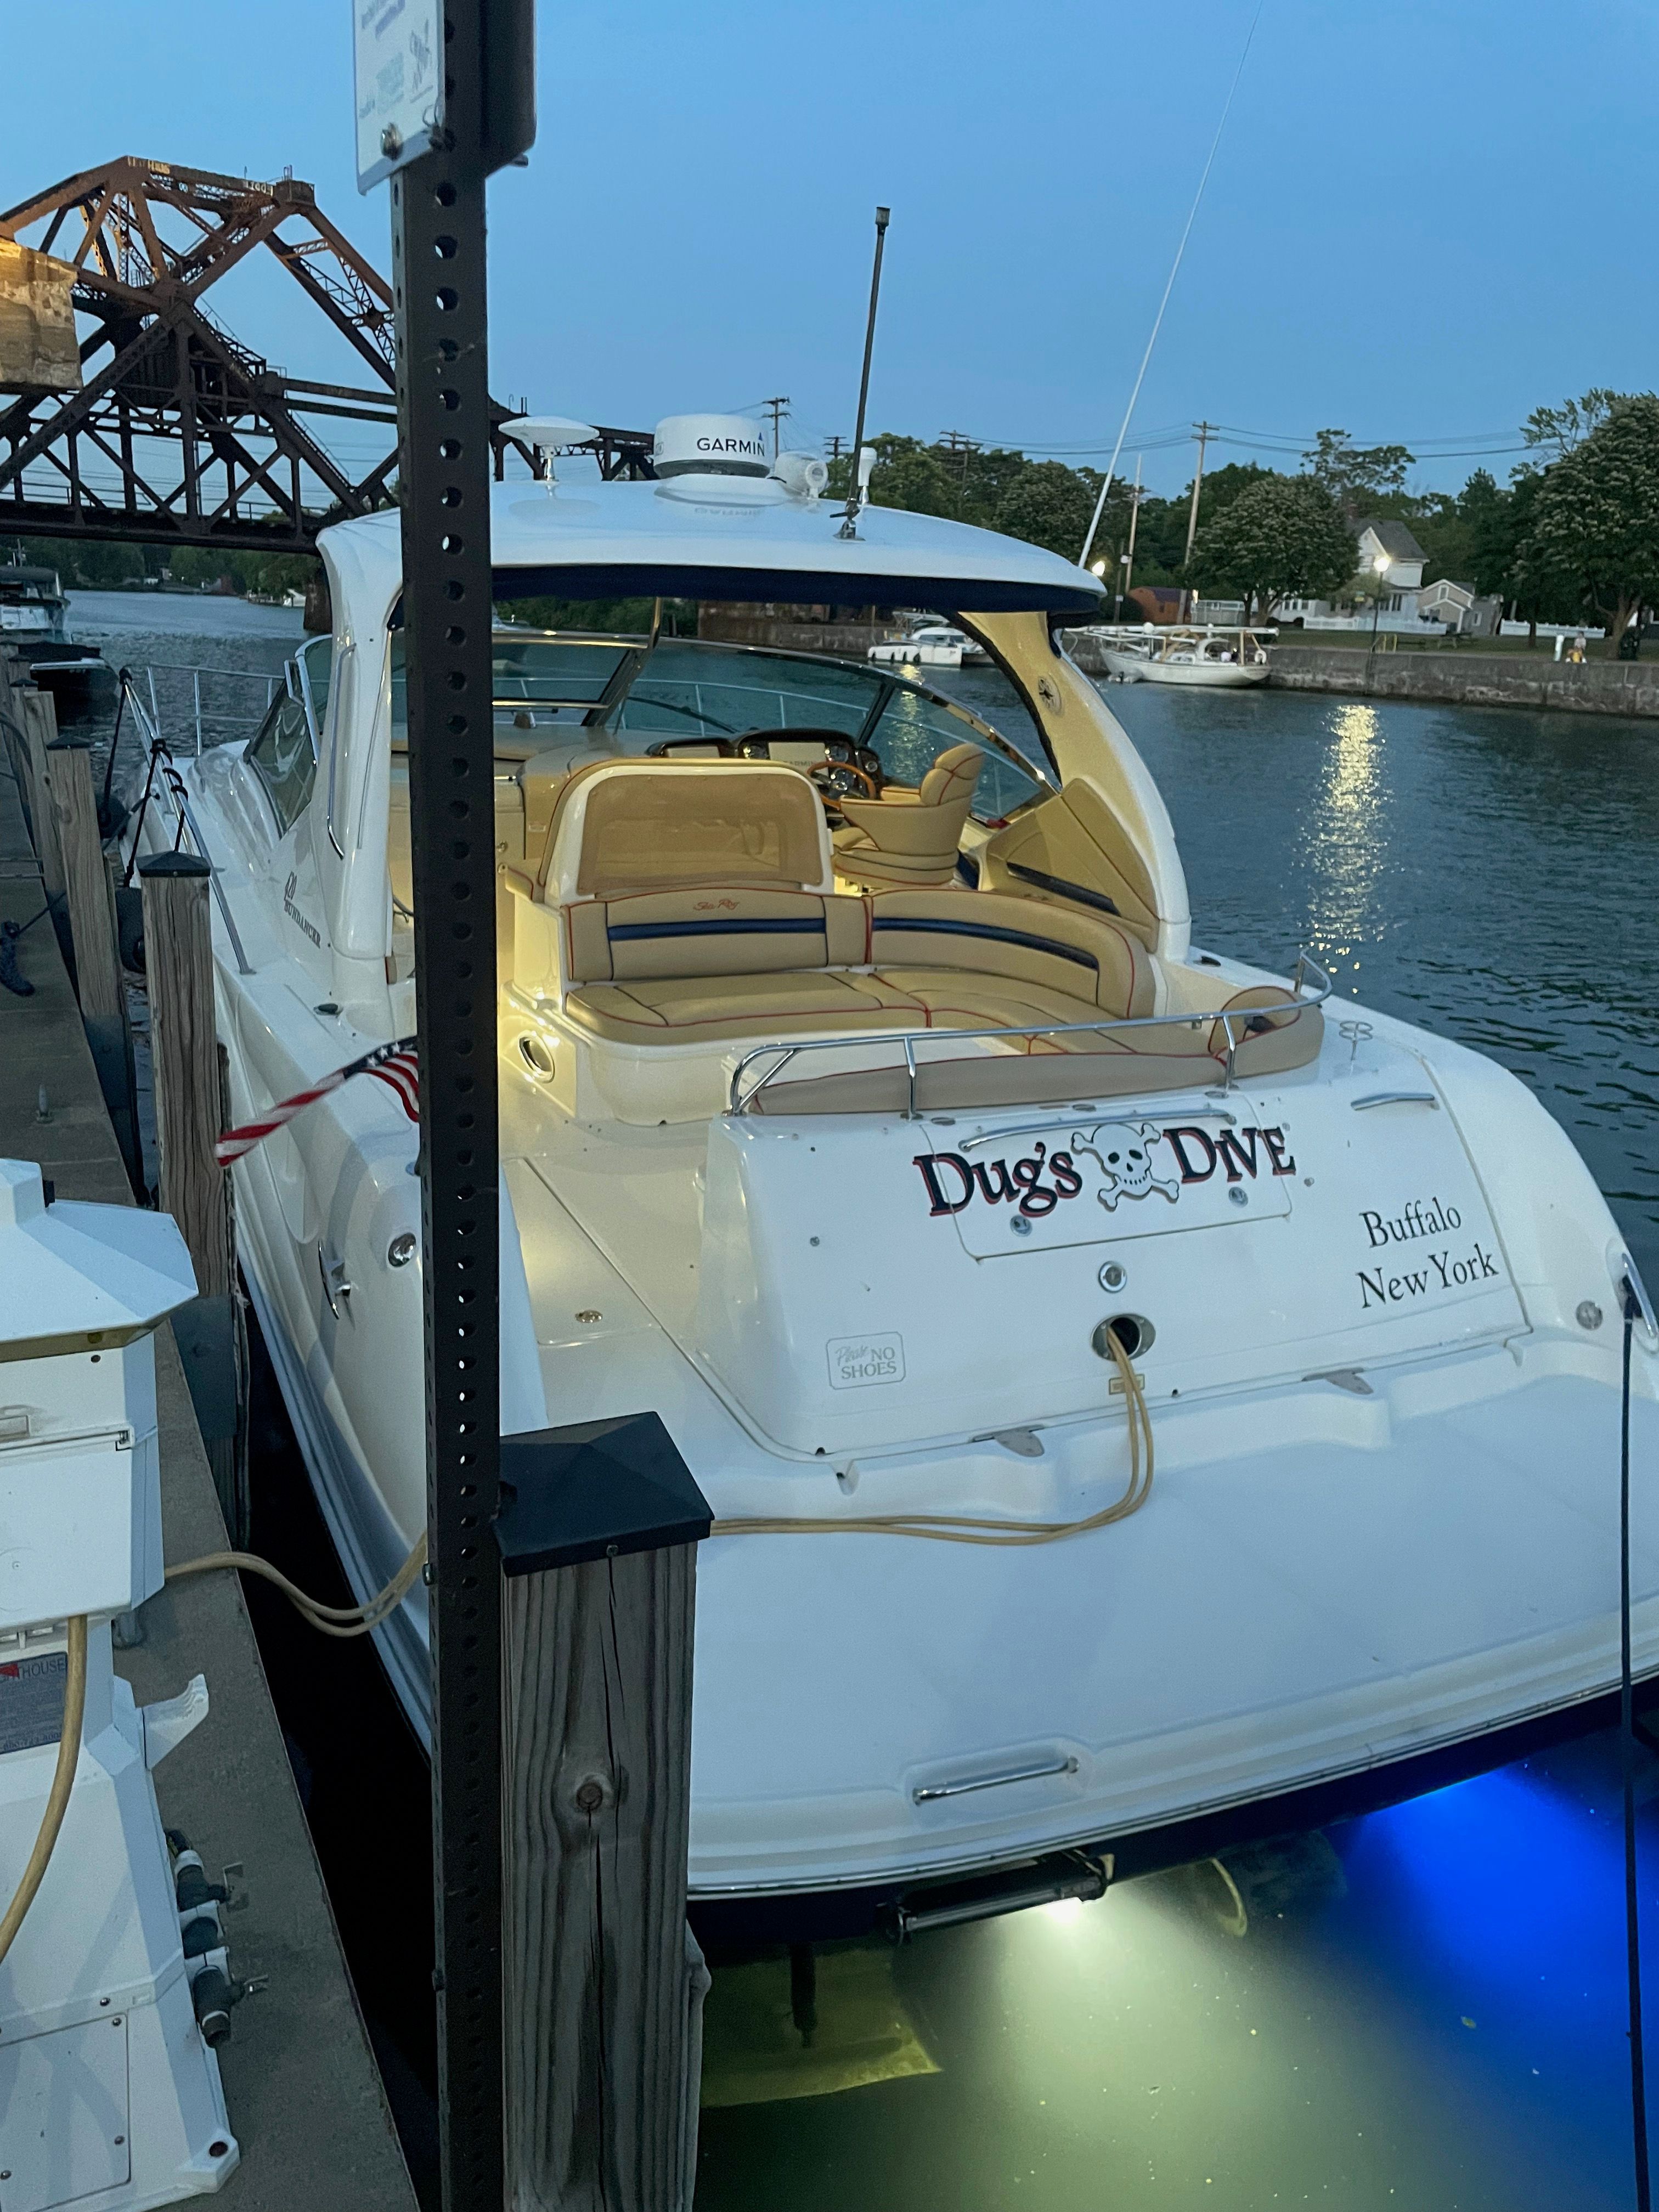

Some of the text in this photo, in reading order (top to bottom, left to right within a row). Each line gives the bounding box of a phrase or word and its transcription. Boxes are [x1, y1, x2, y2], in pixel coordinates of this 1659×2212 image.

[697, 438, 765, 456] GARMIN
[284, 899, 321, 949] SUNDANCER
[912, 1126, 1297, 1217] Dug's DIVE
[1358, 1197, 1461, 1248] Buffalo
[1355, 1242, 1499, 1309] New York
[841, 1361, 897, 1379] SHOES
[871, 1346, 895, 1362] NO
